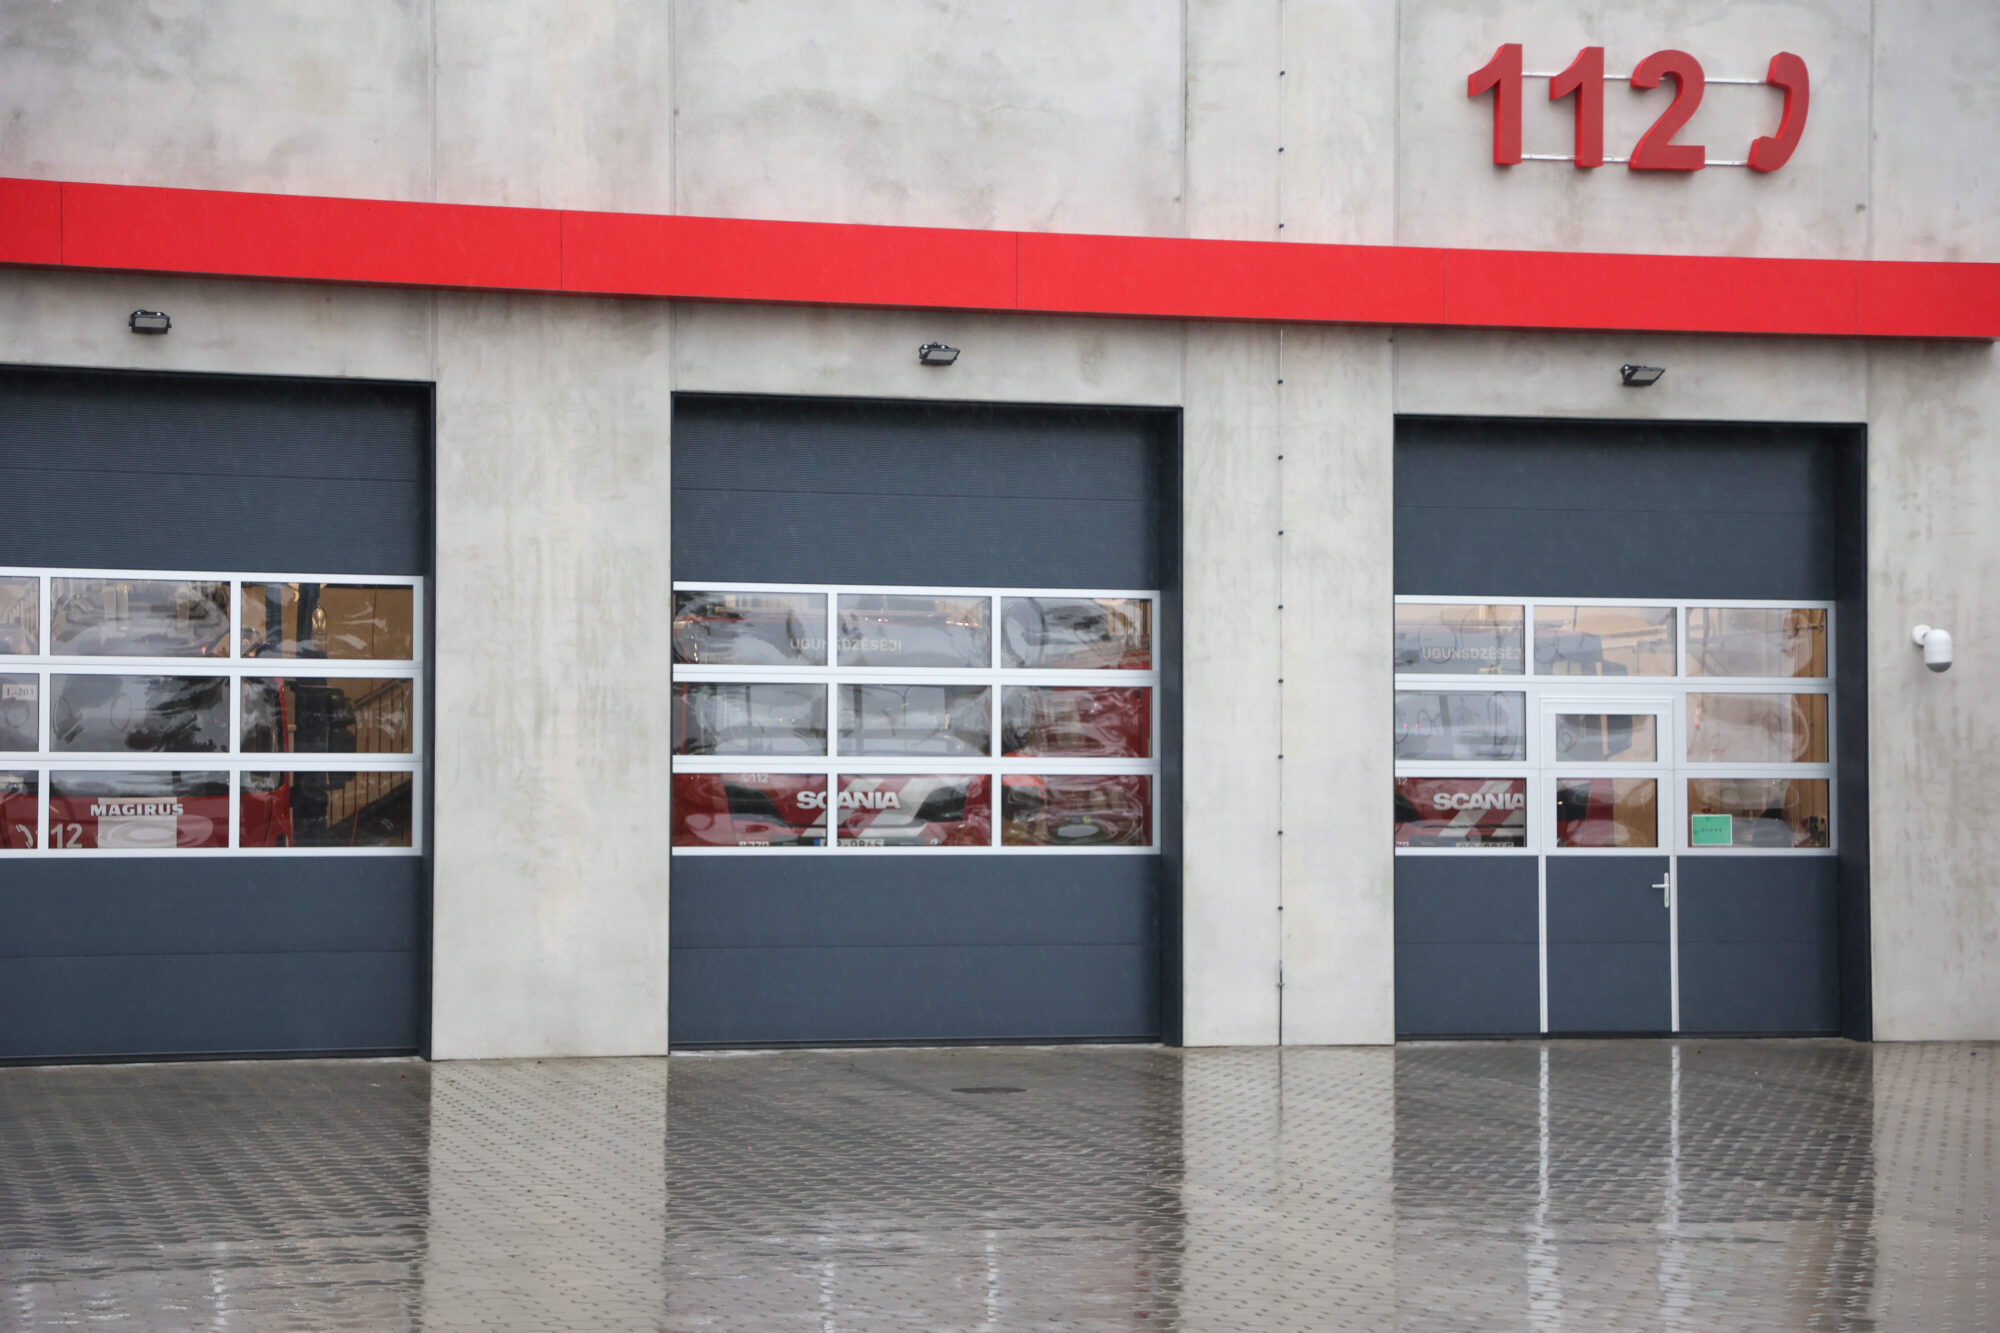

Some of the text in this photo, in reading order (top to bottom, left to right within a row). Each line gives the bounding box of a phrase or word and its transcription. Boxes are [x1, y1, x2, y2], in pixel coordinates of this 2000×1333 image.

[1468, 43, 1705, 171] 112
[1422, 645, 1522, 660] UGUNSDZĒSĒJ
[90, 803, 184, 817] MAGIRUS
[1433, 792, 1524, 811] SCANIA
[50, 823, 83, 848] 12
